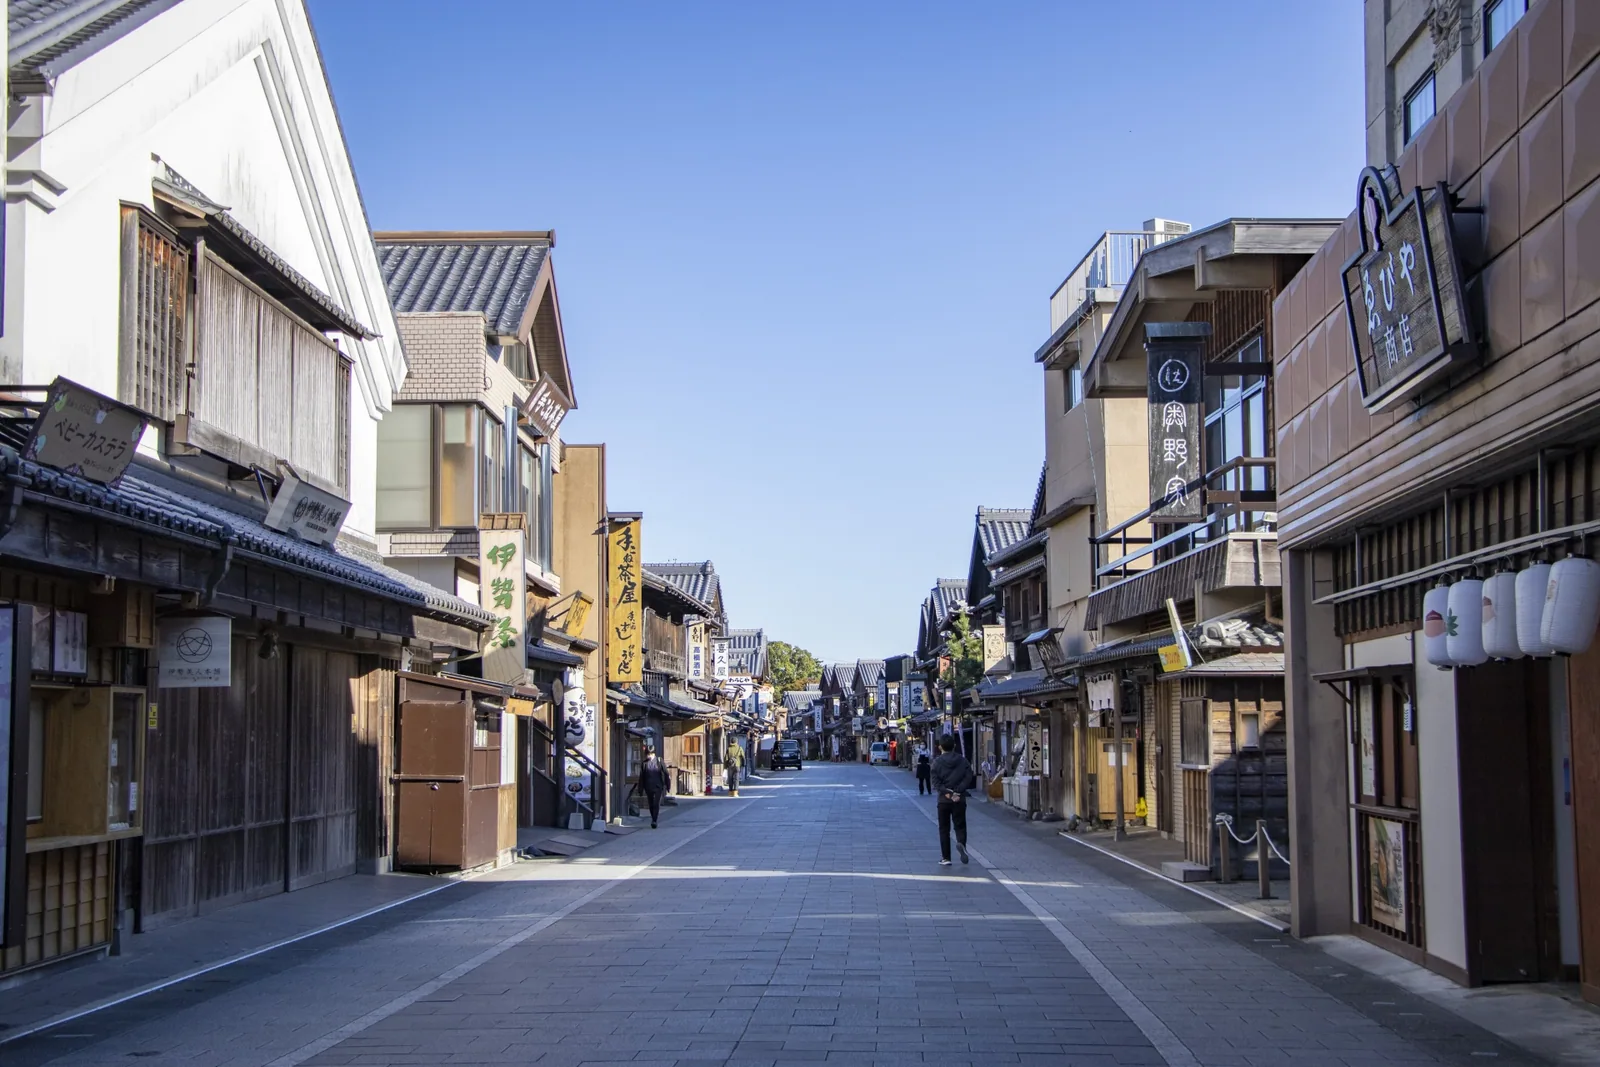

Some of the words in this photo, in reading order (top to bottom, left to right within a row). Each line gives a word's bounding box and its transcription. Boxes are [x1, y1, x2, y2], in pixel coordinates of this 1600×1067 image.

[1384, 313, 1413, 370] 商店
[54, 418, 128, 460] ベビーカステラ
[486, 542, 518, 649] 伊勢茶
[716, 643, 727, 677] 喜久屋
